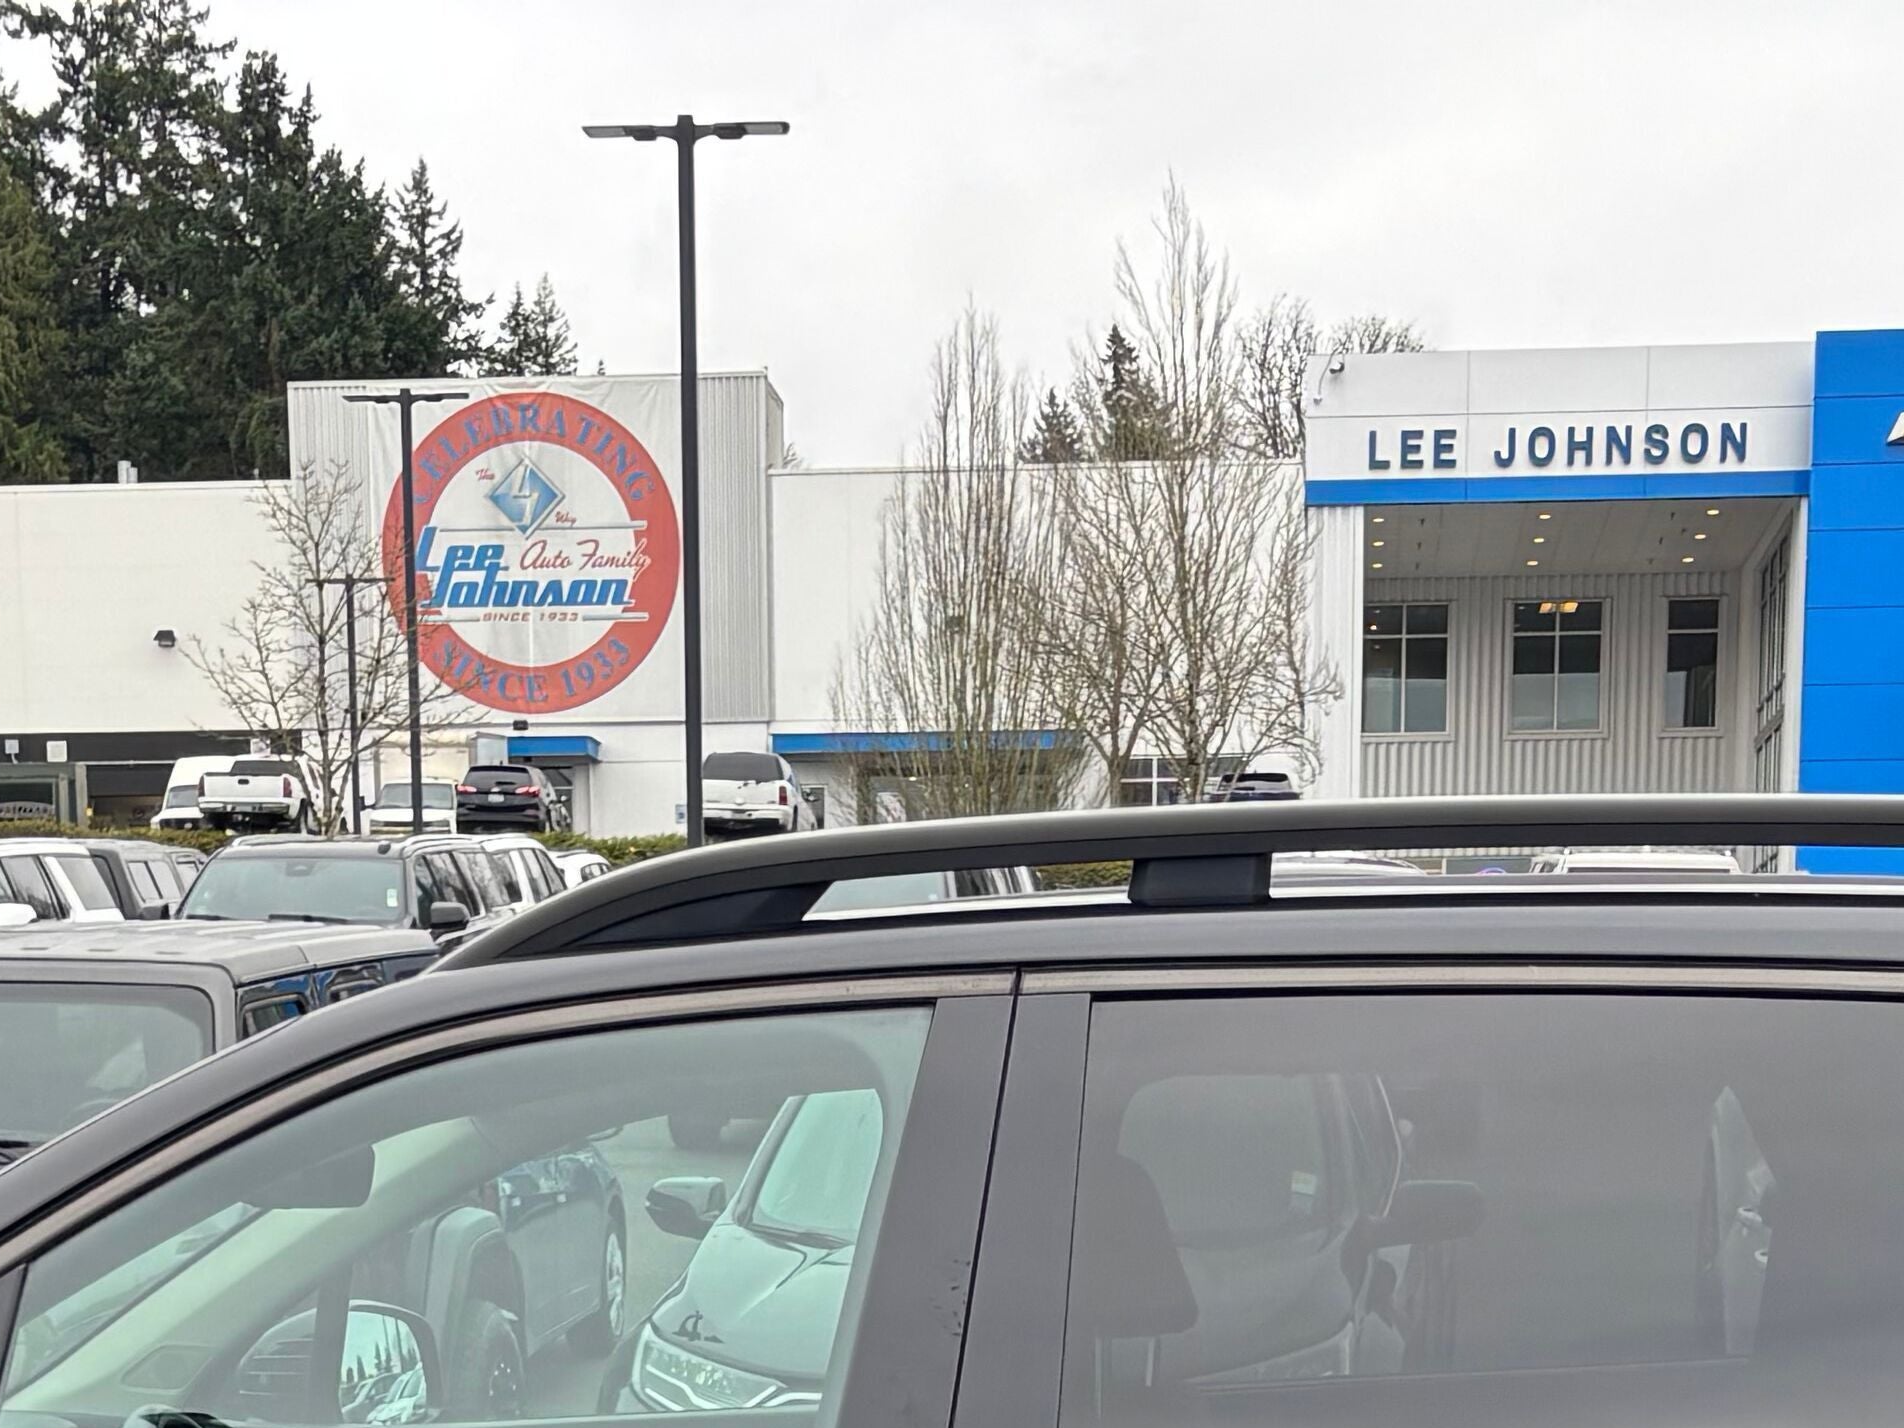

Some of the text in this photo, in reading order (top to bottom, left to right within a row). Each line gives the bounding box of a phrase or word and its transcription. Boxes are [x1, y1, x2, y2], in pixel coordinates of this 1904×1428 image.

[1368, 421, 1749, 471] LEE JOHNSON
[415, 526, 652, 583] Lee Auto Family
[419, 561, 636, 609] Johnson
[482, 612, 579, 622] SINCE 1933
[433, 637, 630, 703] SINCE 1933
